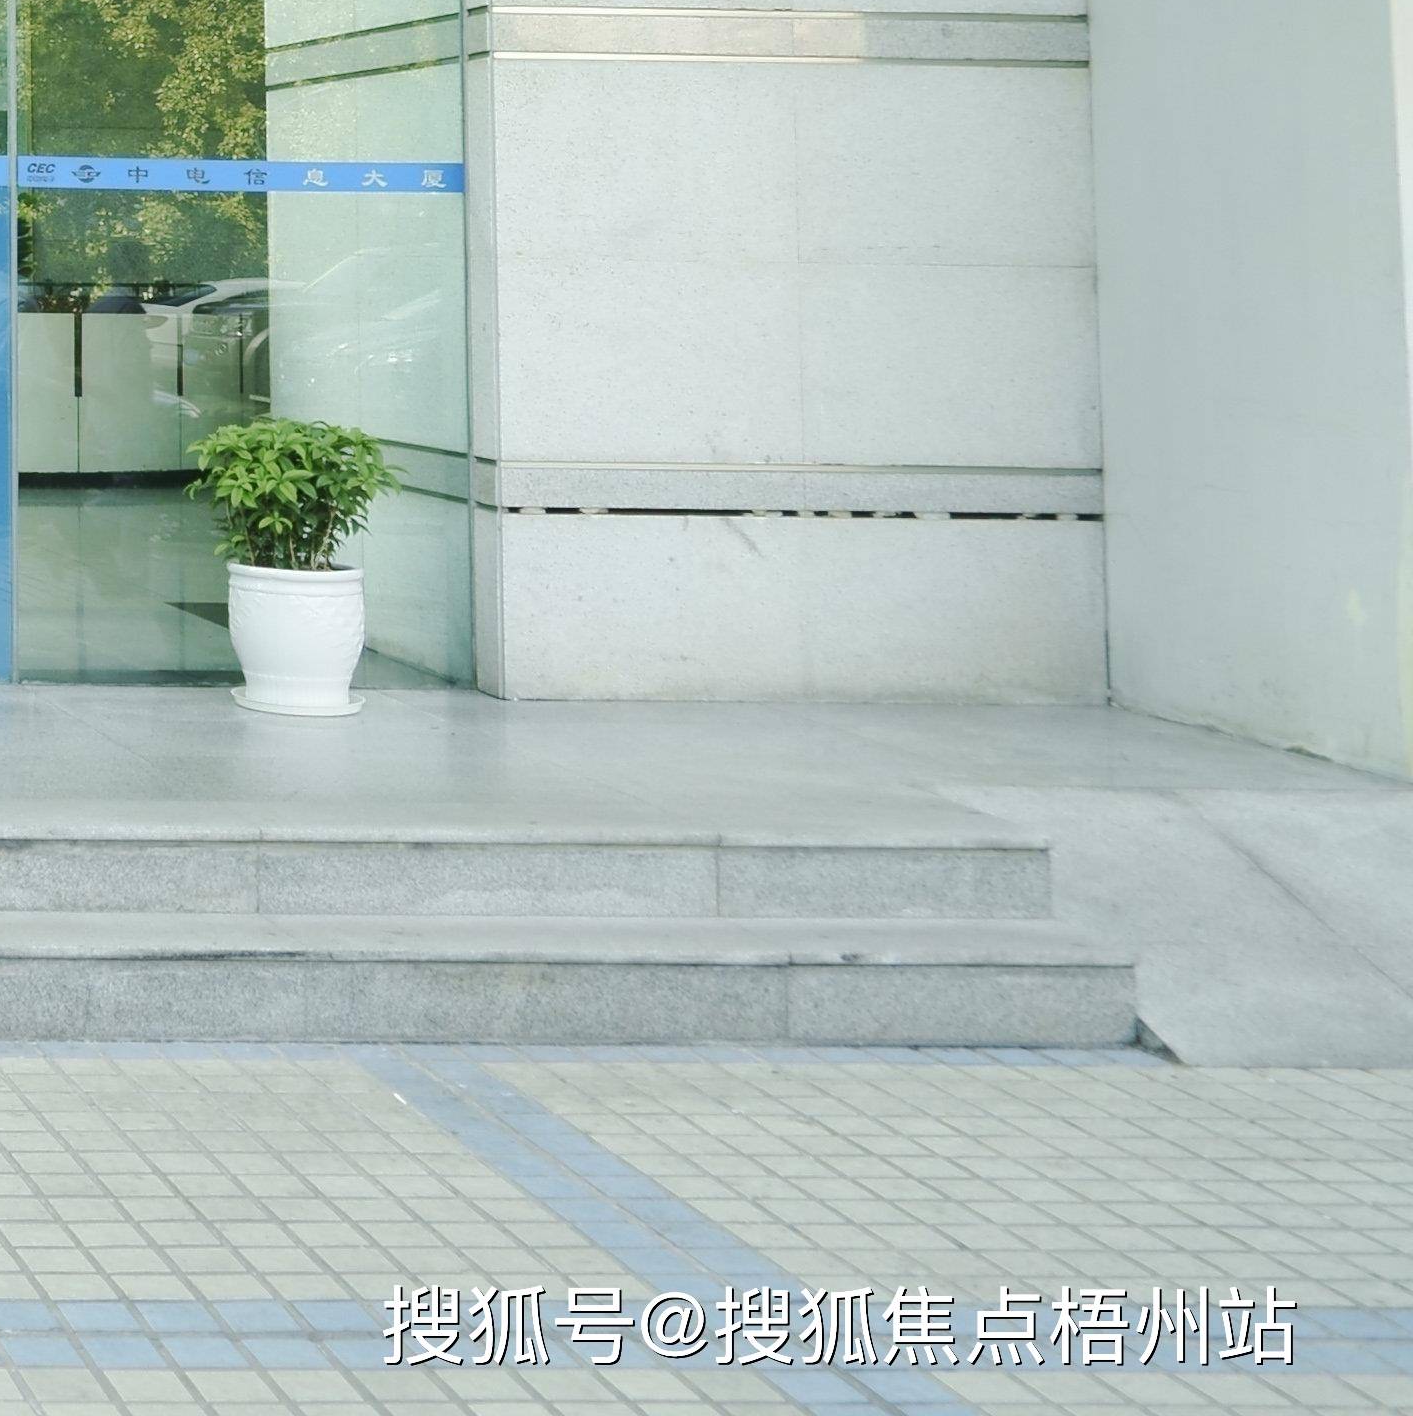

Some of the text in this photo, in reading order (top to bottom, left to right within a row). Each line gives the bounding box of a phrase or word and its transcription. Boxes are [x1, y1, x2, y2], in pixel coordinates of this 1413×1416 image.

[27, 163, 56, 174] CEC
[127, 165, 448, 189] 中电信息大厦
